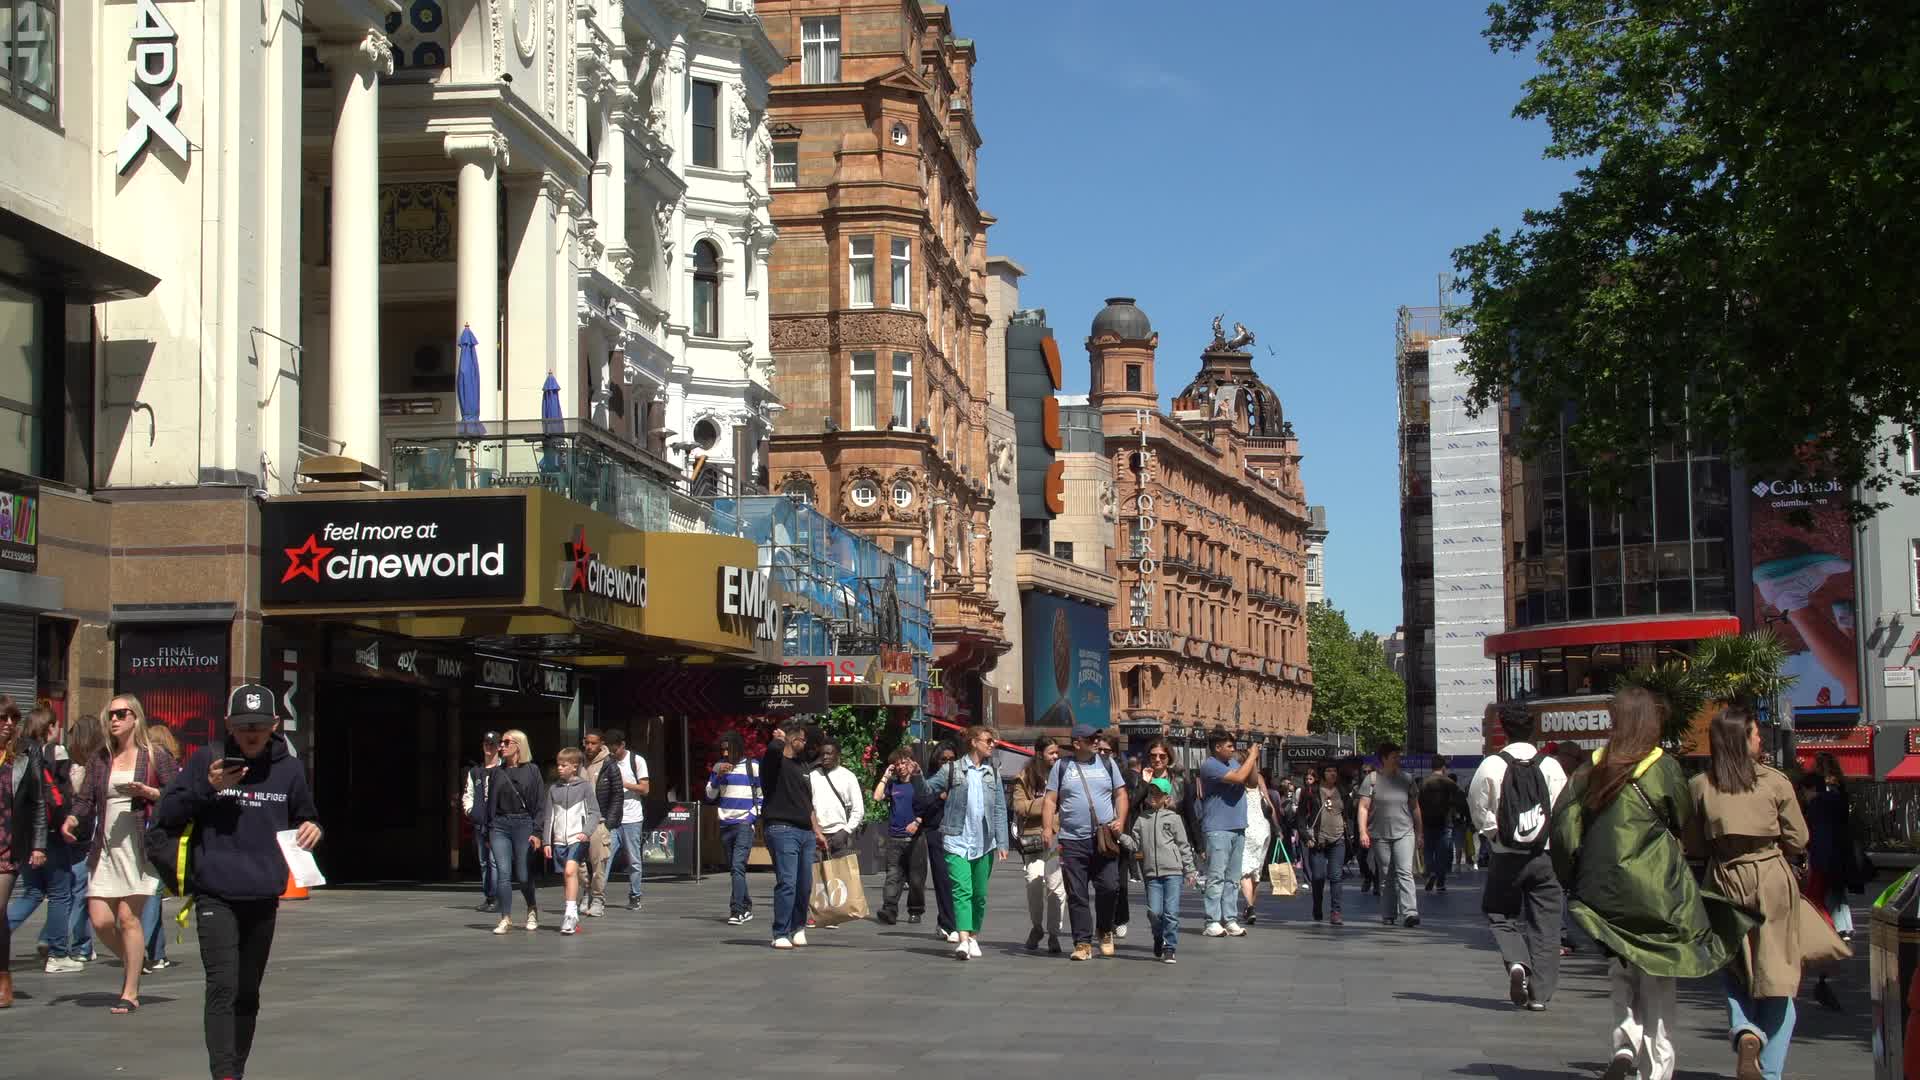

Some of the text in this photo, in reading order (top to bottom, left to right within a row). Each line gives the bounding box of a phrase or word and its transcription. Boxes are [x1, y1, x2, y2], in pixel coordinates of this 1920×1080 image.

[1136, 409, 1156, 617] HIPPODROME
[323, 522, 438, 541] feel more at
[326, 543, 504, 579] cineworld
[588, 552, 648, 608] cineworld
[159, 647, 194, 657] FINAL
[132, 656, 218, 667] DESTINATION
[759, 671, 794, 684] EMPIRE
[744, 683, 810, 696] CASINO
[1541, 709, 1611, 732] BURGER
[1287, 748, 1326, 758] CASINO
